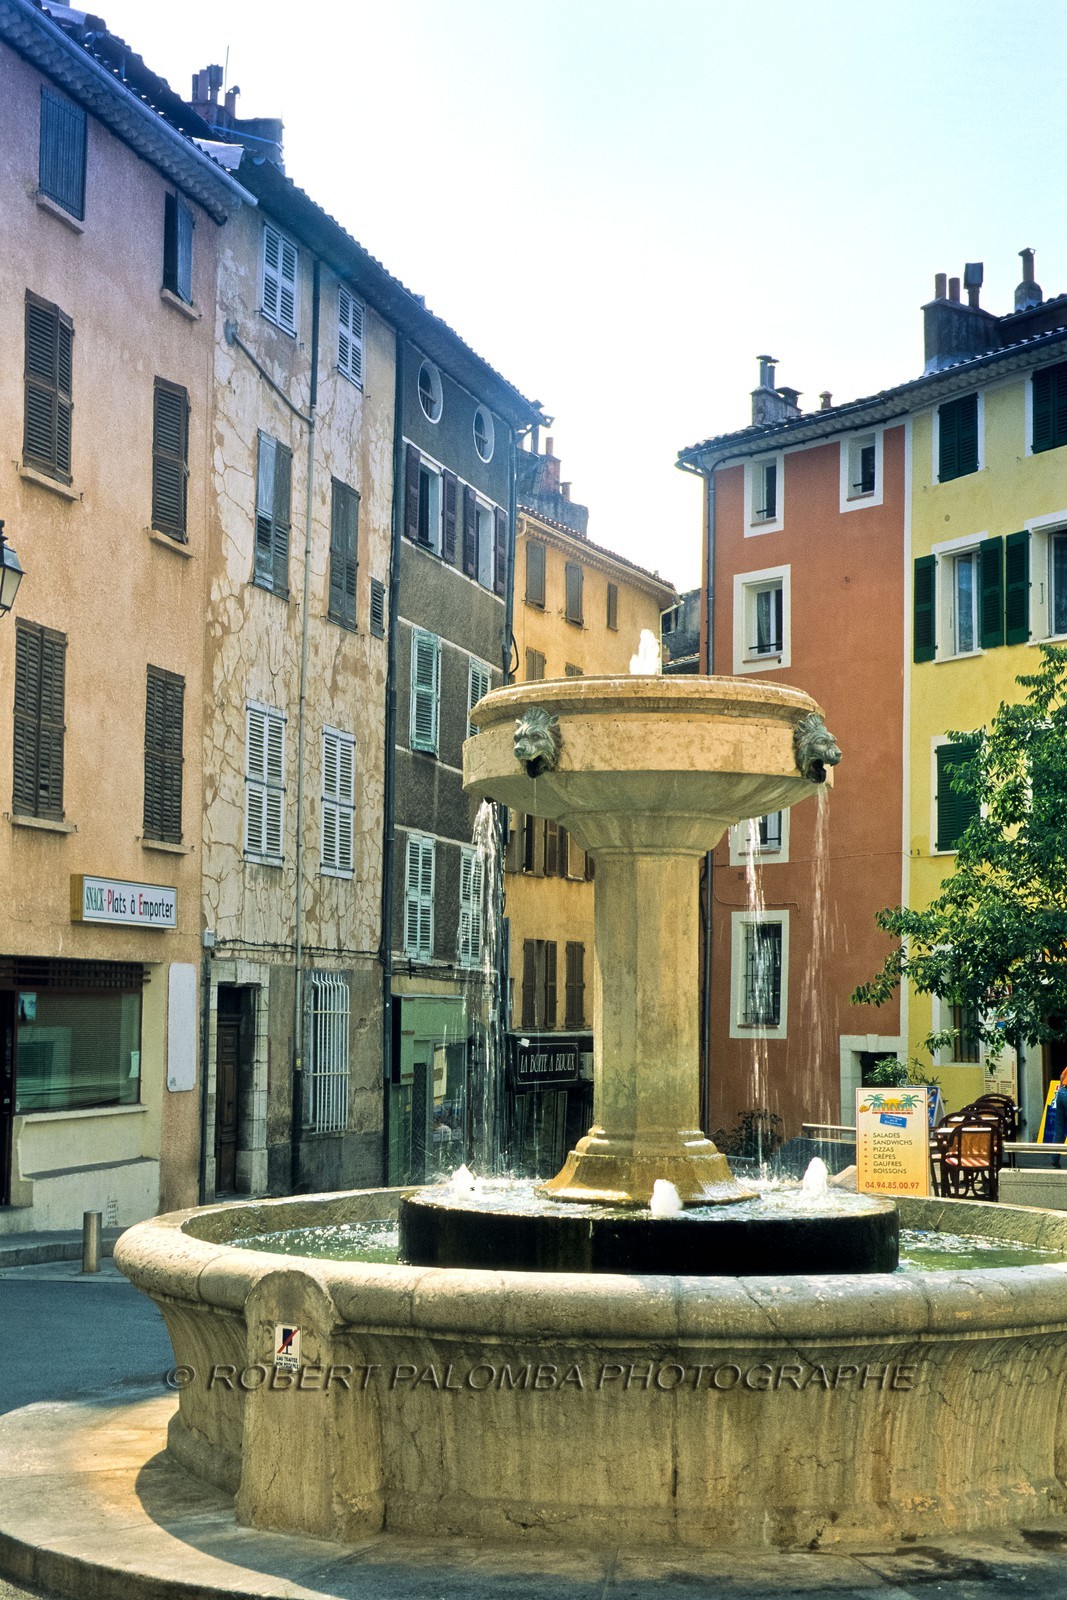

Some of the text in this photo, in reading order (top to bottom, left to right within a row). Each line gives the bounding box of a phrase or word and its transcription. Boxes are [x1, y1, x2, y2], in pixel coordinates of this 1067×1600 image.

[130, 894, 136, 915] à
[138, 893, 174, 921] Emporter
[520, 1054, 528, 1073] LA
[872, 1152, 896, 1160] CRÊPES
[872, 1167, 907, 1175] BOISSONS
[865, 1181, 920, 1190] 04.94.85.00.97
